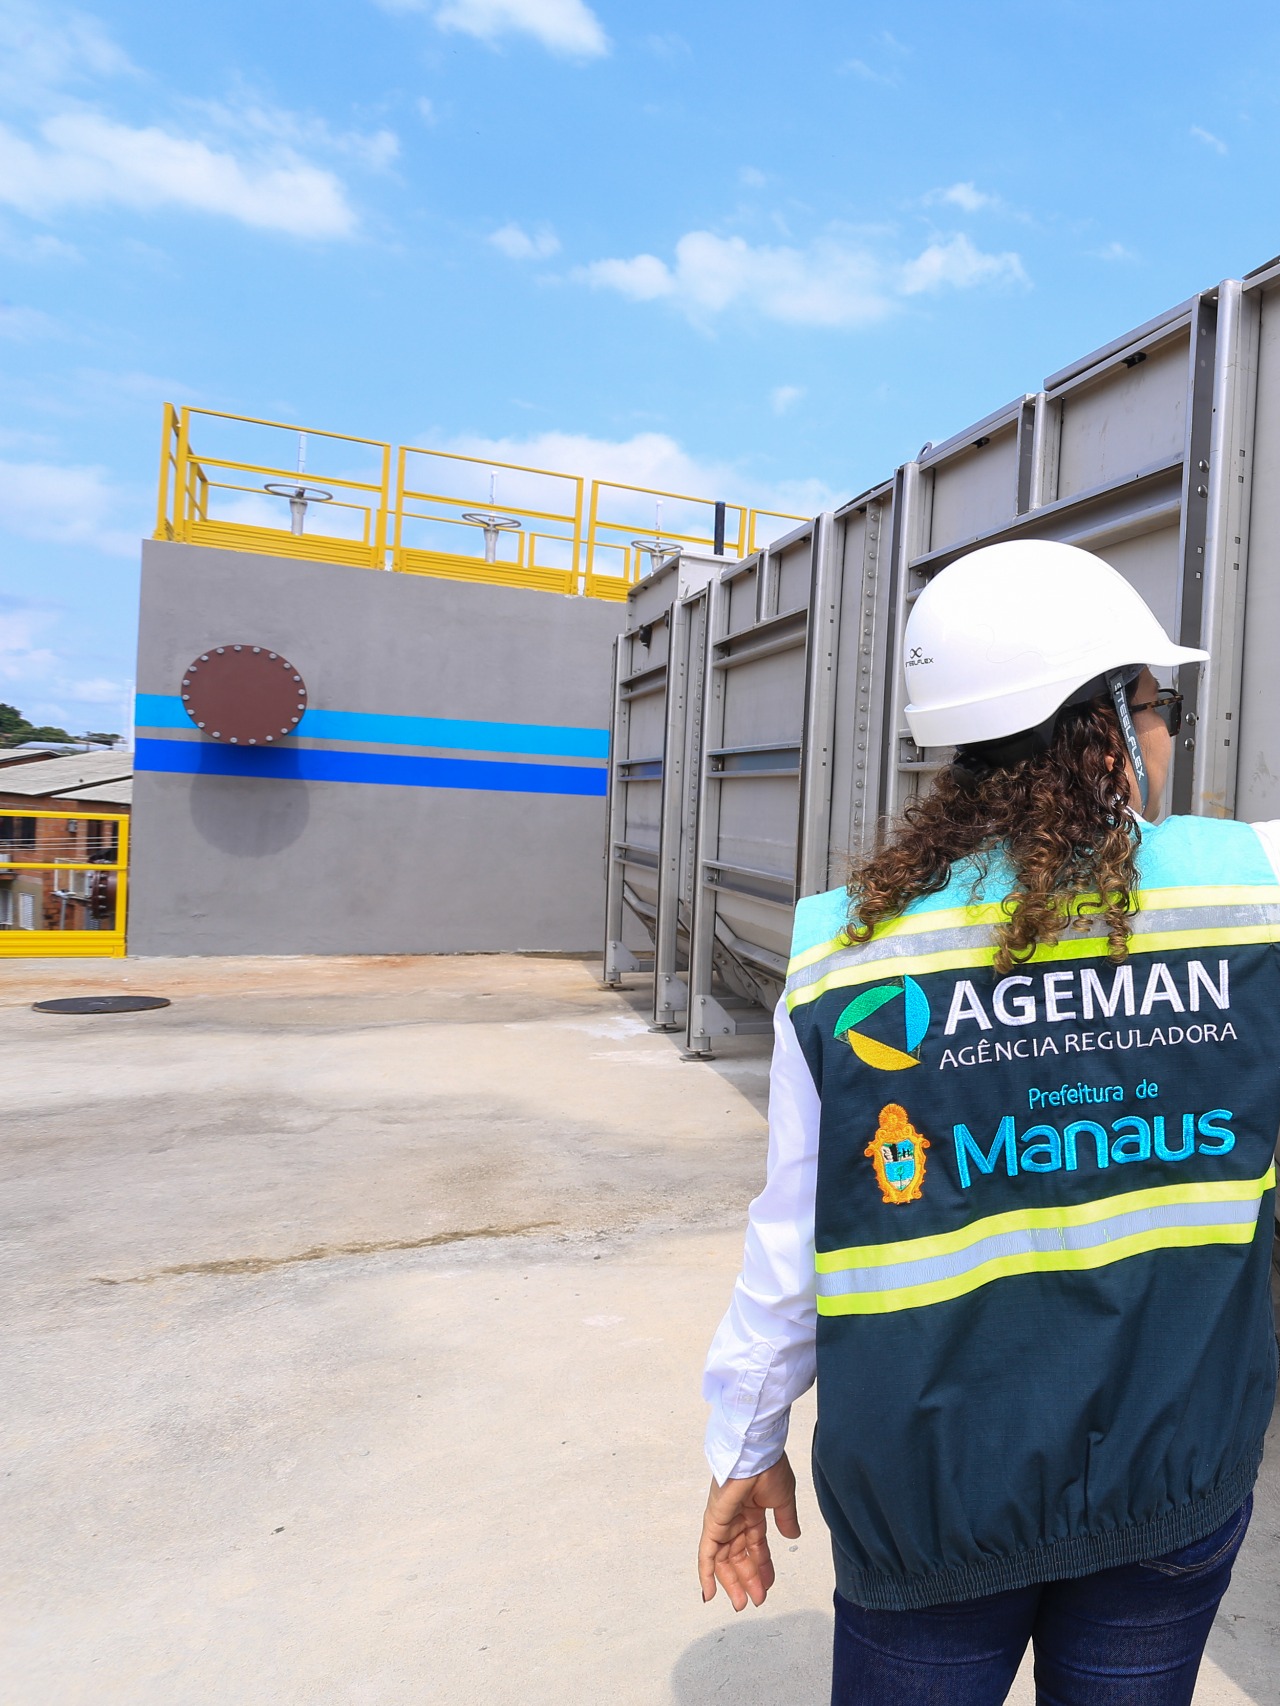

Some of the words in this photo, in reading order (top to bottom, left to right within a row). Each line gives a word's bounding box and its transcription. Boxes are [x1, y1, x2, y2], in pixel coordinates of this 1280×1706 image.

[943, 959, 1231, 1036] AGEMAN
[939, 1038, 1060, 1070] AGÊNCIA
[1064, 1022, 1238, 1054] REGULADORA
[1028, 1082, 1124, 1110] Prefeitura
[1135, 1078, 1159, 1100] de
[953, 1108, 1236, 1189] Manaus
